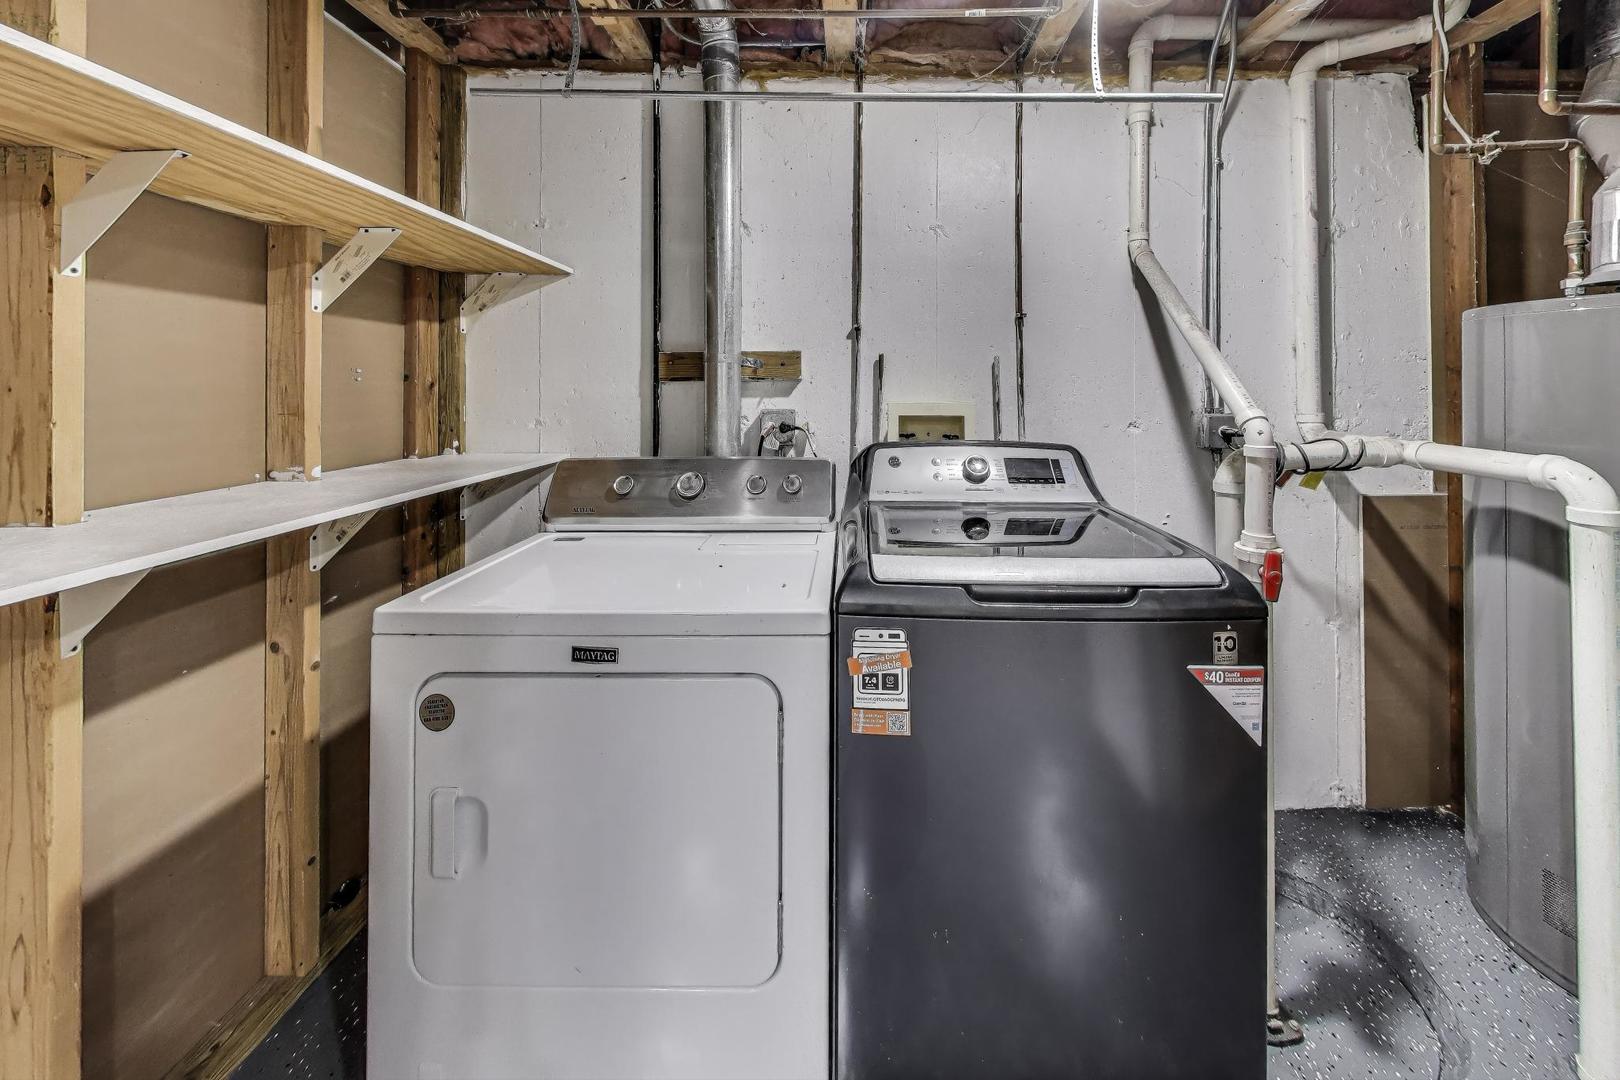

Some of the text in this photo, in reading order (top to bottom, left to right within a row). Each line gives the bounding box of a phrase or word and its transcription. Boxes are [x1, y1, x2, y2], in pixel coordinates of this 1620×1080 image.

[1214, 635, 1237, 652] 10
[574, 650, 615, 661] MAYTAG
[862, 660, 902, 673] Available
[1204, 671, 1224, 683] $40
